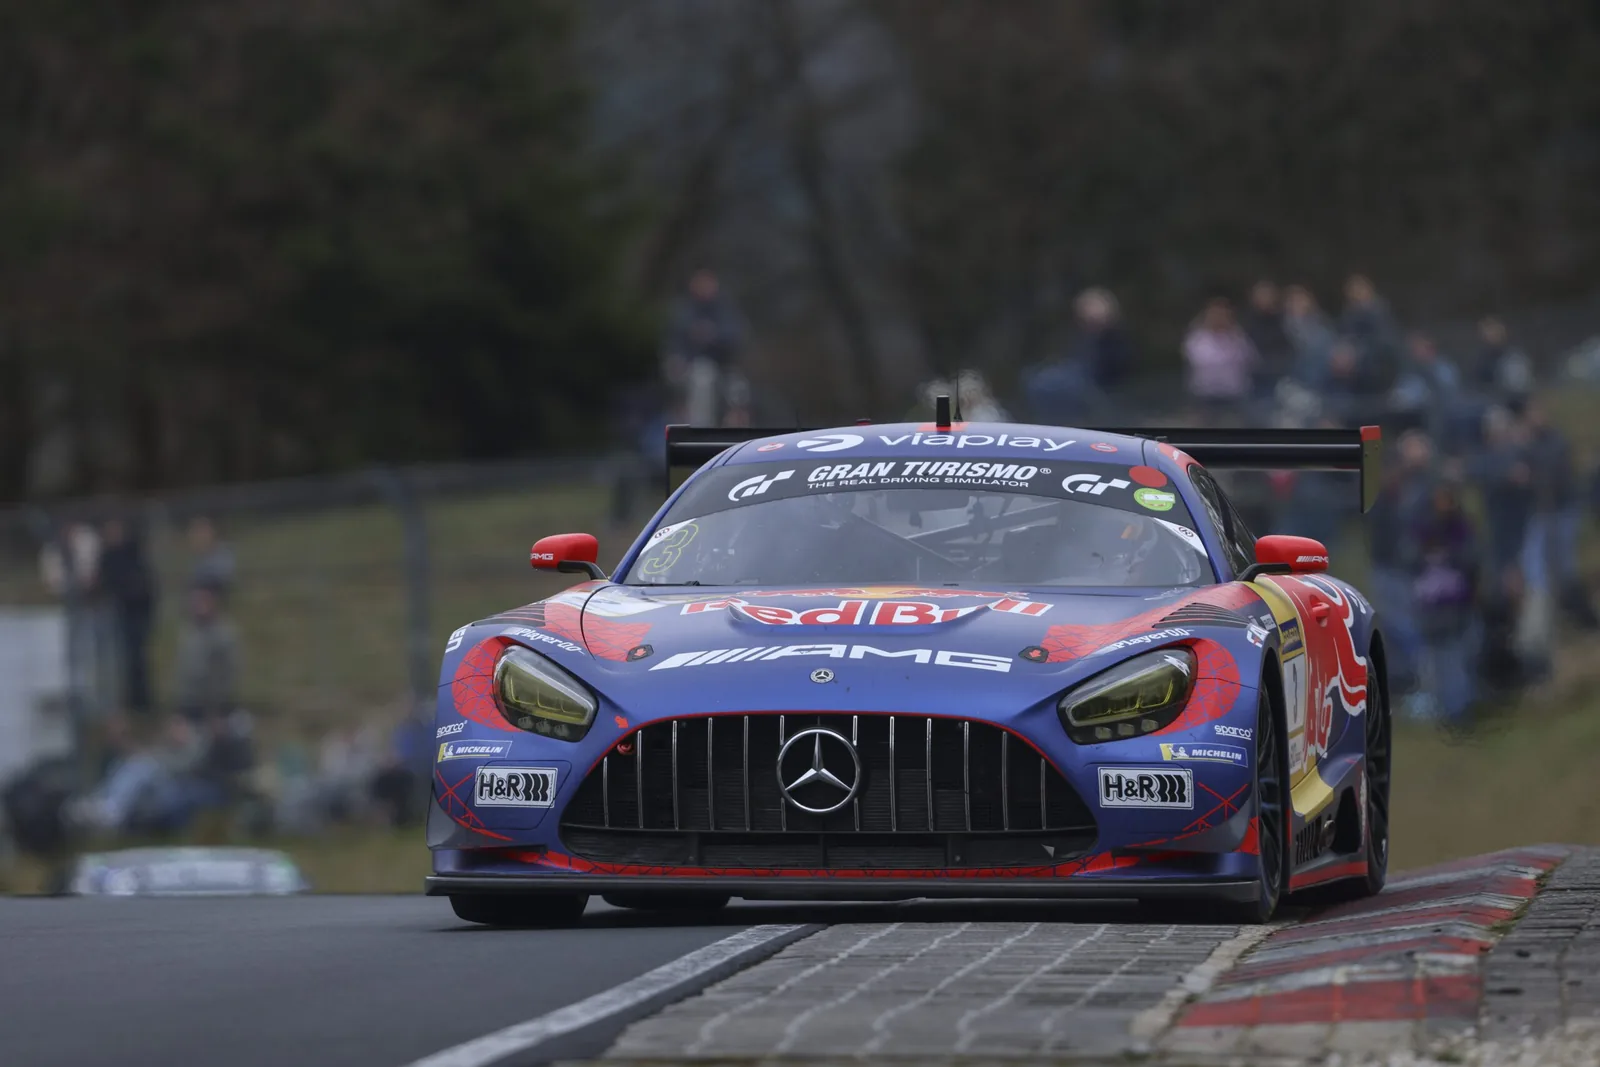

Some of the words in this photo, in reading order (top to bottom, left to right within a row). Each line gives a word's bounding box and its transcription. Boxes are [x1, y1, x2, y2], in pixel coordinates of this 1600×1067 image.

[879, 432, 1076, 451] viaplay
[807, 462, 896, 482] GRAN
[807, 481, 835, 489] THE
[944, 477, 1029, 488] SIMULATOR
[759, 644, 1013, 672] AMG
[437, 722, 464, 737] sparco
[1214, 724, 1251, 739] sparco
[455, 745, 504, 754] MICHELIN
[1191, 748, 1242, 760] MICHELIN
[479, 773, 522, 799] H&R
[1103, 773, 1157, 801] H&R
